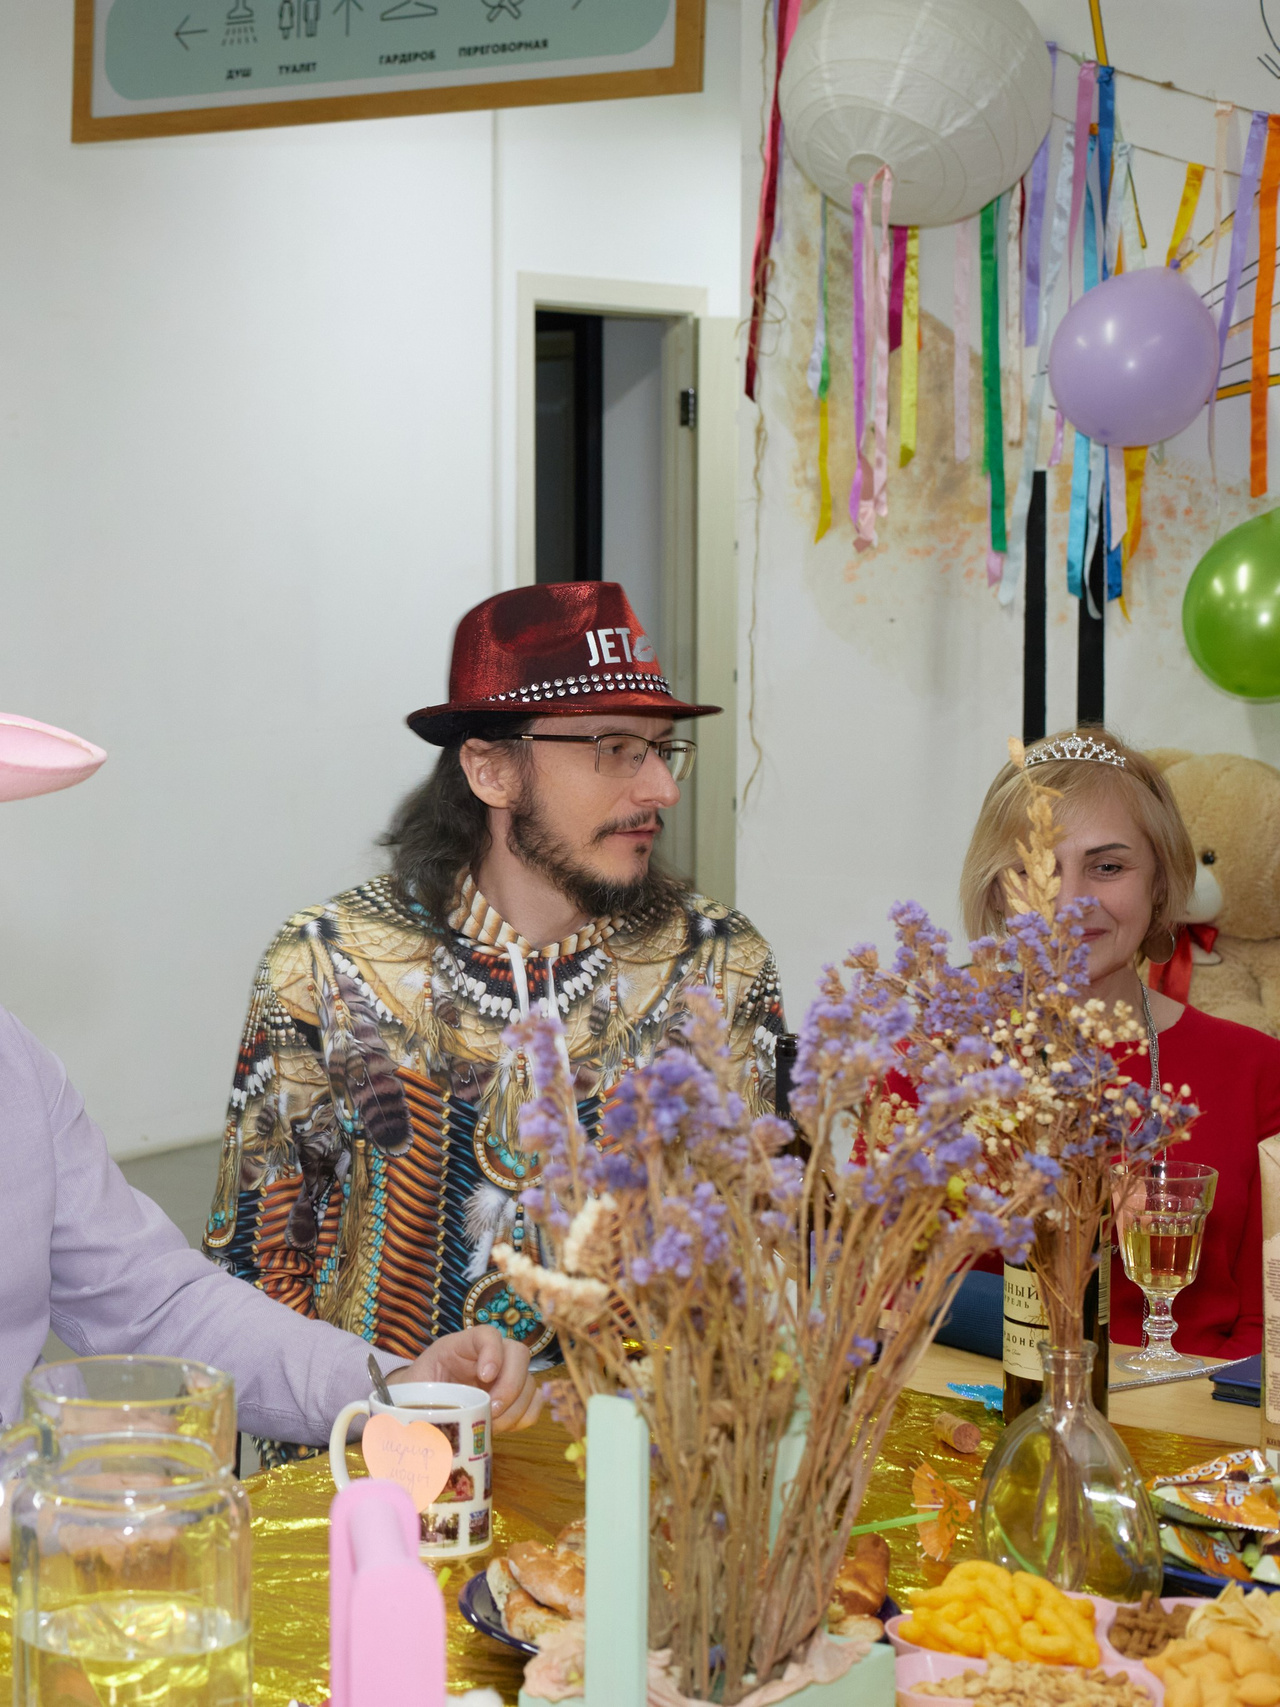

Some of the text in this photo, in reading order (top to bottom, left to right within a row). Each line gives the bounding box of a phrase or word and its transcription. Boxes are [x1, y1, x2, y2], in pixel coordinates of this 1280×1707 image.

[458, 38, 548, 58] ПЕРЕГОВОРНАЯ
[379, 49, 436, 65] ГАРДЕРОБ
[225, 67, 252, 80] ДУШ
[278, 62, 318, 75] ТУАЛЕТ
